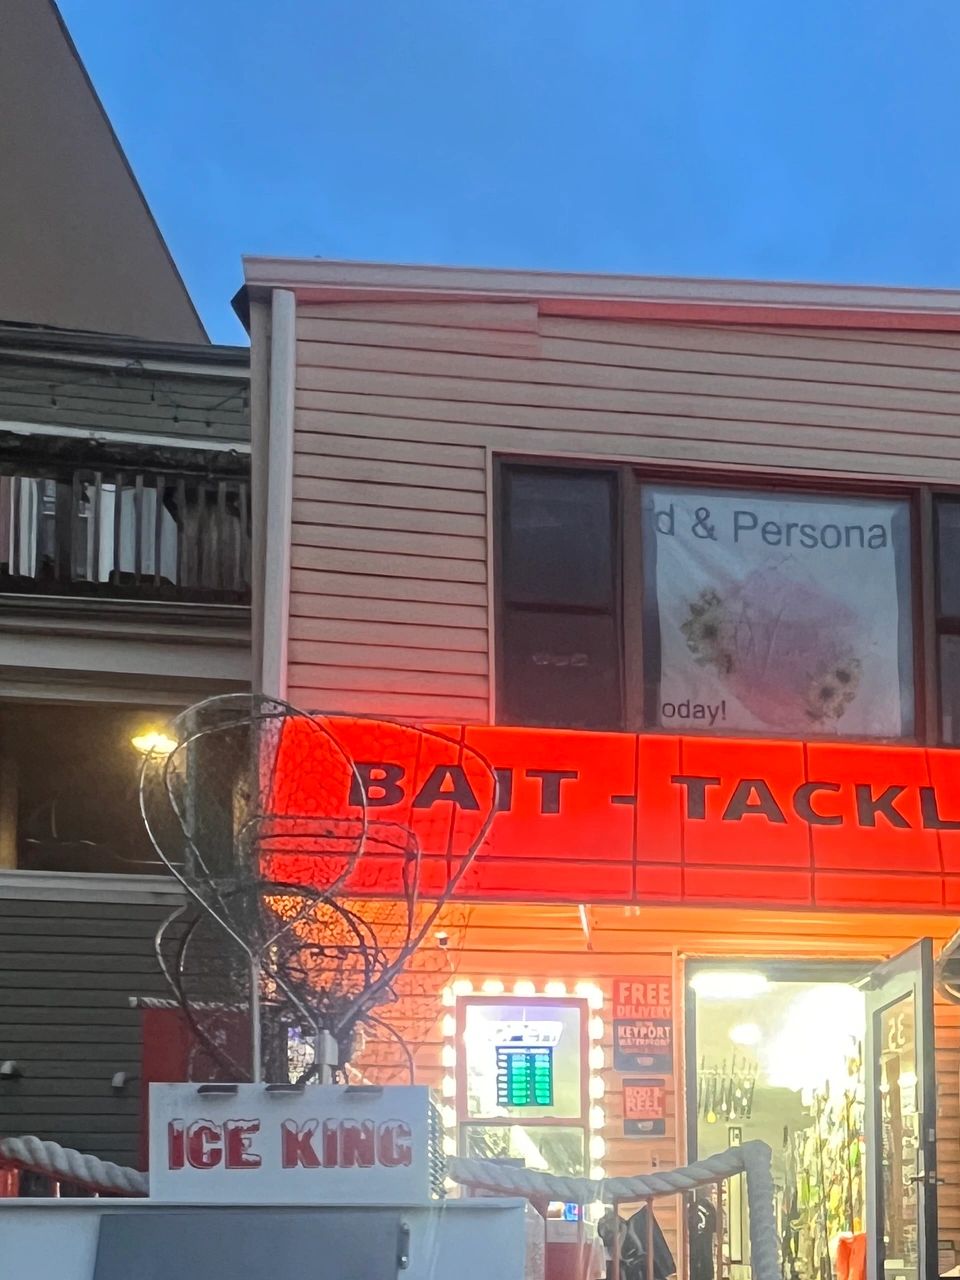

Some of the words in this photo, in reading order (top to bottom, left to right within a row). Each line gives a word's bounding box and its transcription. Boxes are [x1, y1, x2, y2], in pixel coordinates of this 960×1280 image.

[691, 507, 718, 541] &
[733, 510, 888, 550] Persona
[661, 700, 727, 727] oday!
[349, 761, 579, 815] BAIT
[618, 982, 670, 1005] FREE
[616, 1005, 672, 1018] DELIVERY
[617, 1025, 671, 1038] KEYPORT
[167, 1117, 262, 1171] ICE
[280, 1116, 414, 1170] KING
